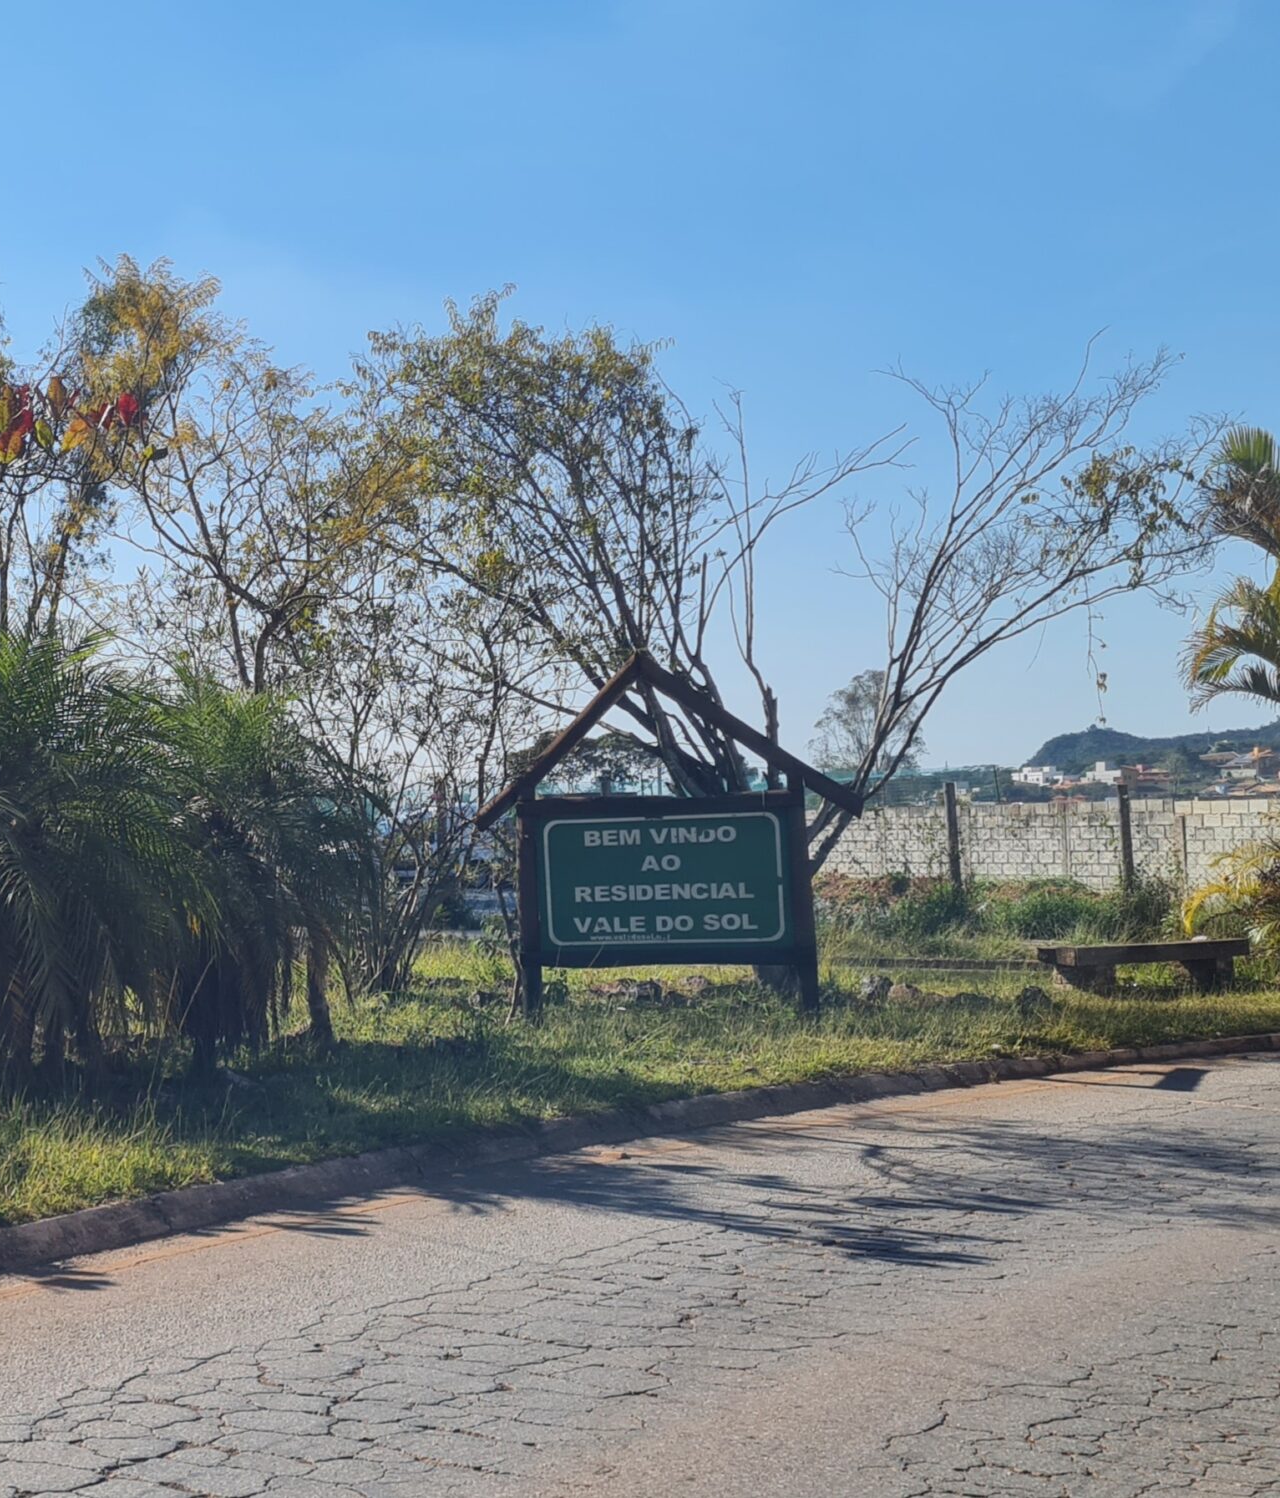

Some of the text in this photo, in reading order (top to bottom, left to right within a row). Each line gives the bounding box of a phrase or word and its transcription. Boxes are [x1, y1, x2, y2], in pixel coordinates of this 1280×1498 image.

[583, 825, 737, 847] BEM VINDO
[640, 854, 682, 872] AO
[574, 881, 755, 903] RESIDENCIAL
[572, 913, 759, 934] VALE DO SOL
